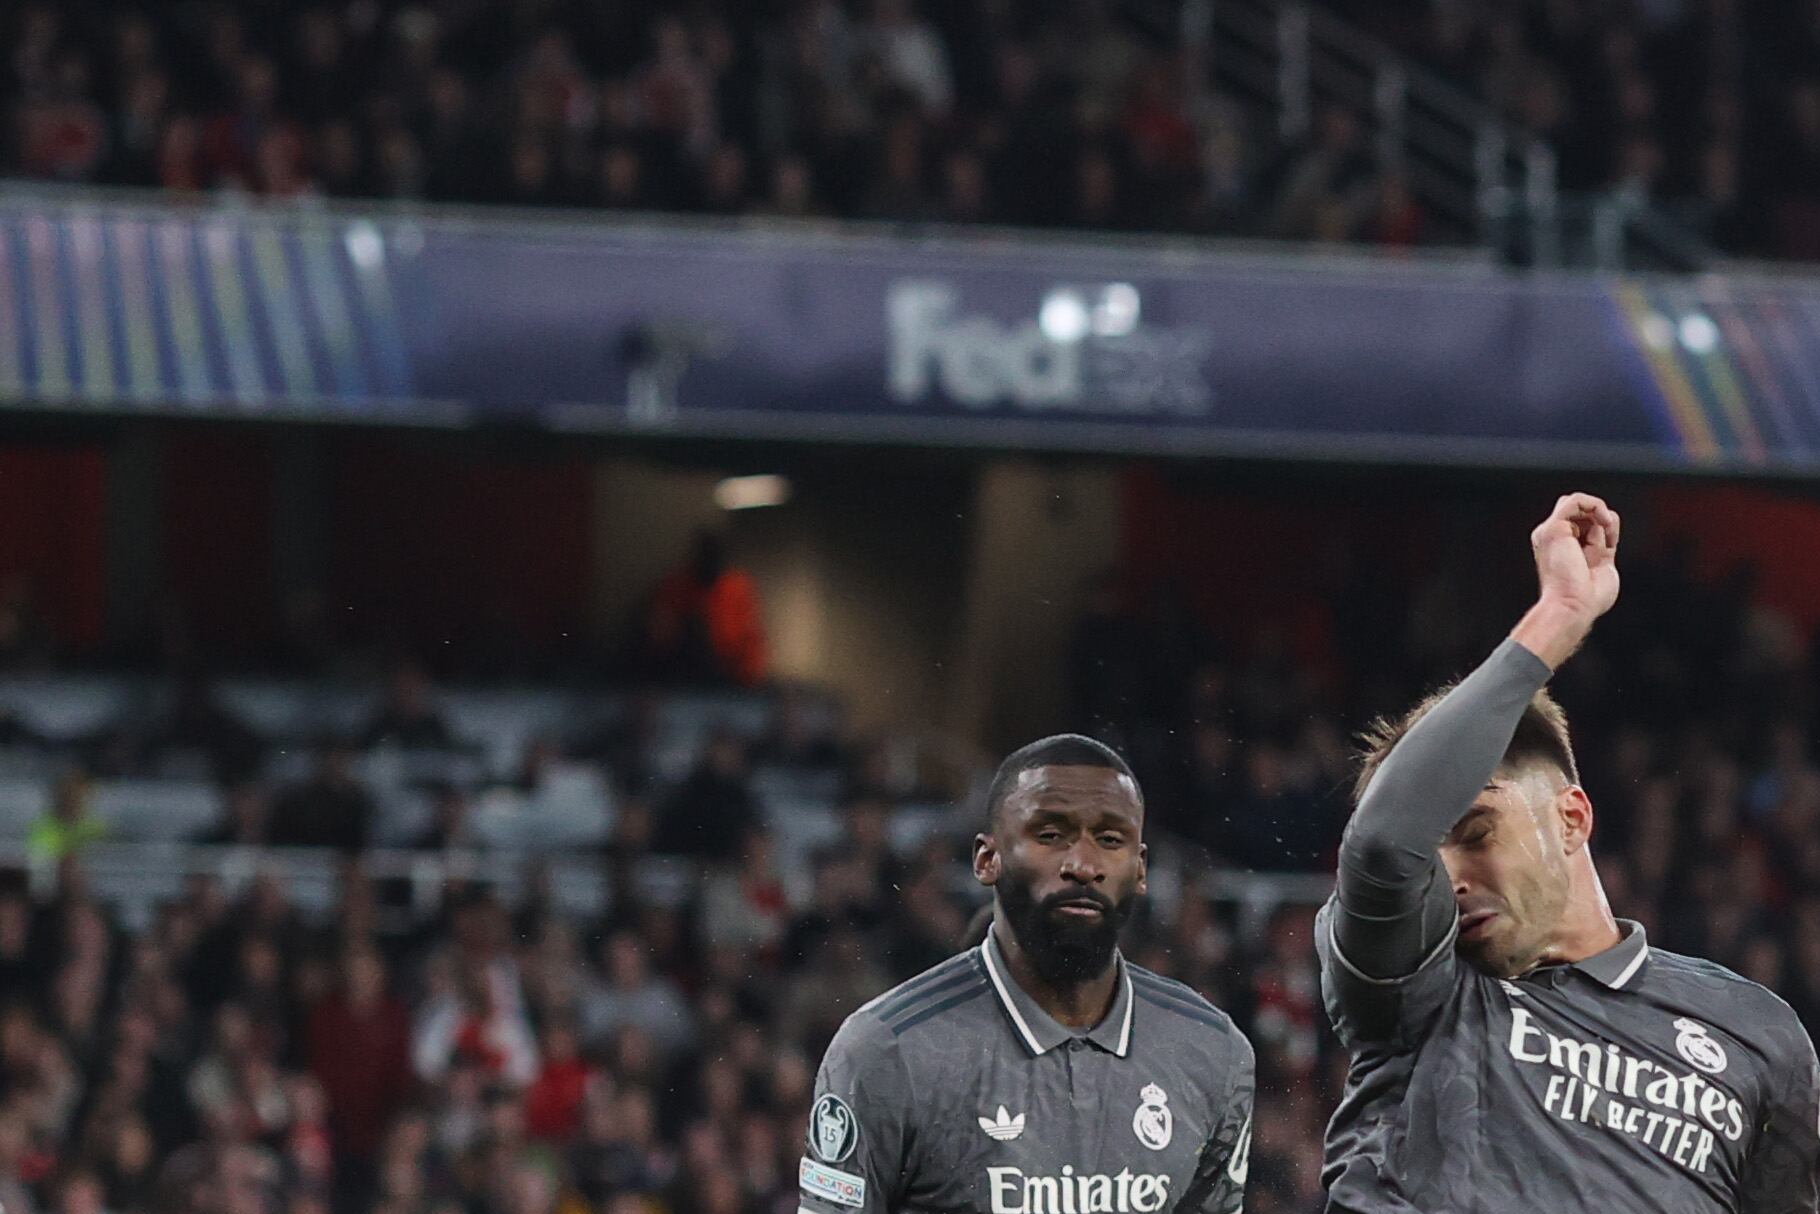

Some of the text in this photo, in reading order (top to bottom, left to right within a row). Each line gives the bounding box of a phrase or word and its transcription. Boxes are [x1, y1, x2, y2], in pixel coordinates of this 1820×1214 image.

[1509, 1008, 1744, 1141] Emirates
[1544, 1074, 1714, 1173] FLY BETTER
